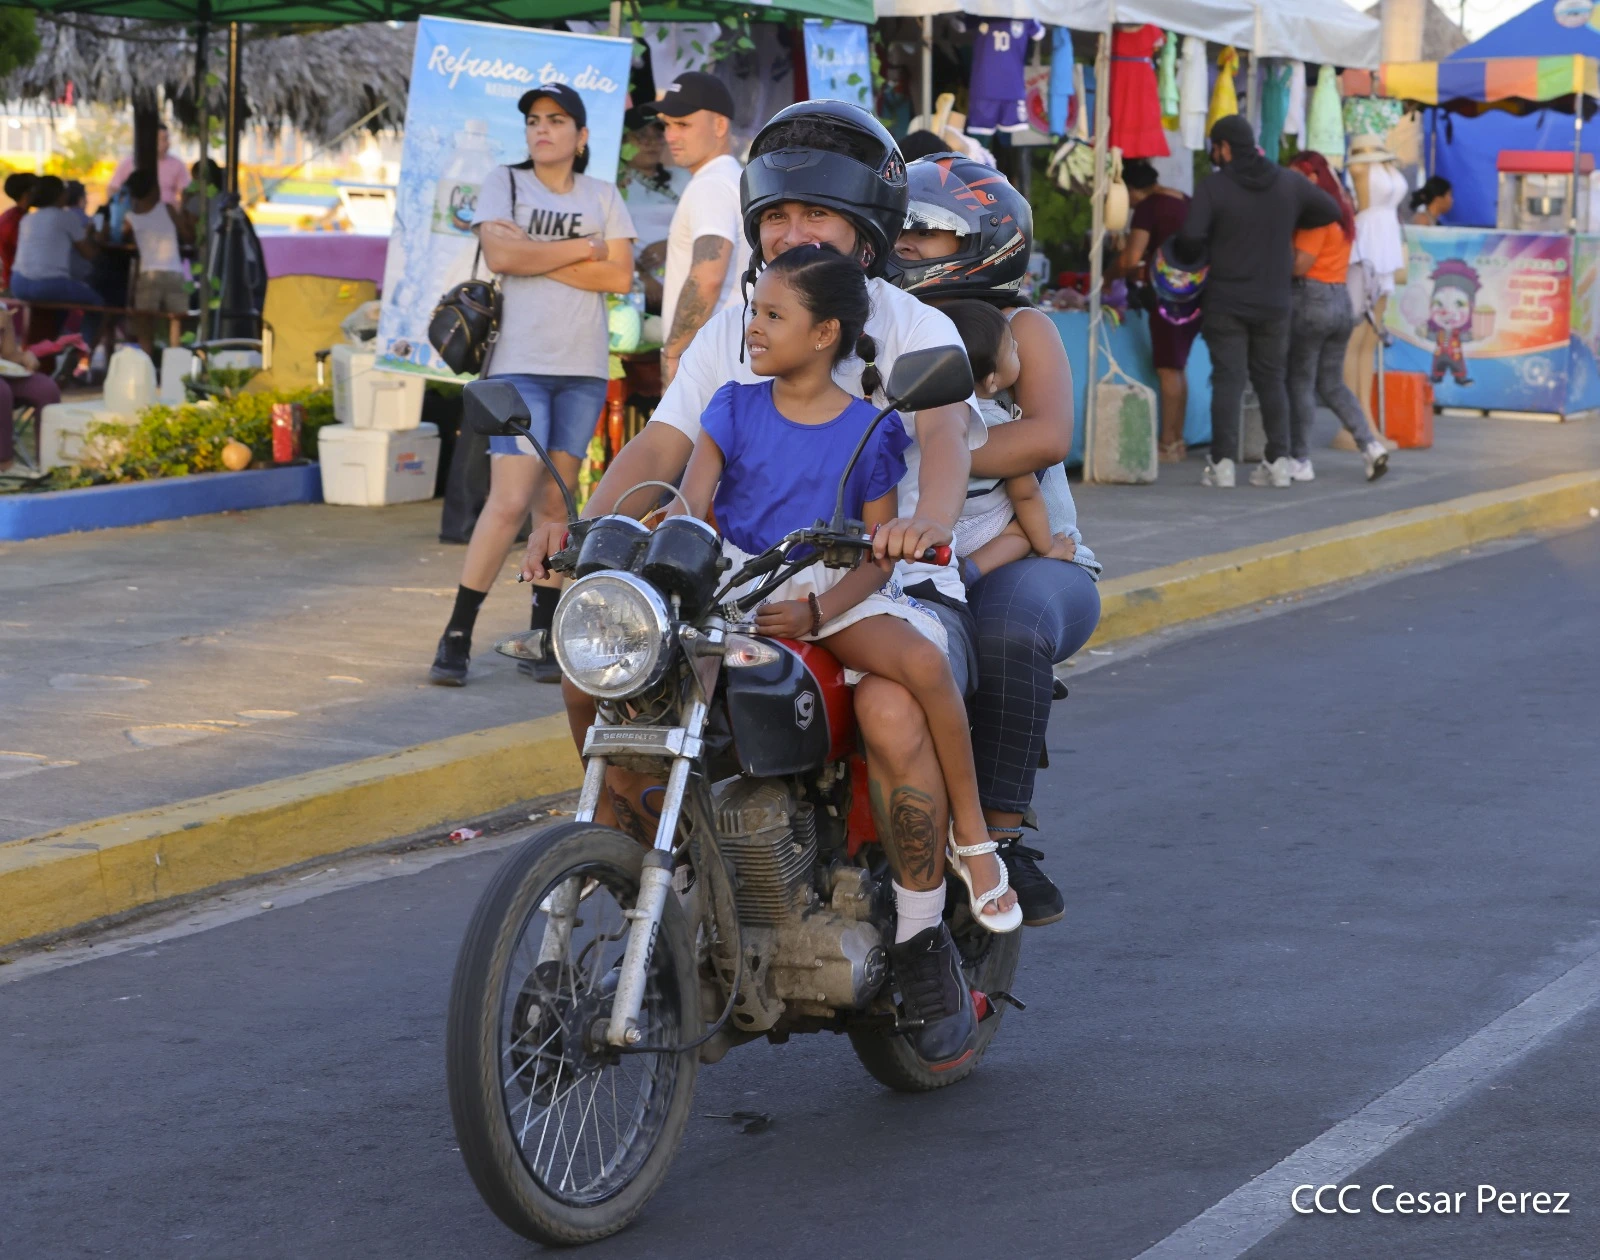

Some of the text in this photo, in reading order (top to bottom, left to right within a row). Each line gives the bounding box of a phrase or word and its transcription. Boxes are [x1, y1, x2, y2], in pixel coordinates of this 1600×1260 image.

[993, 30, 1010, 52] 10
[427, 44, 535, 90] Refresca
[538, 62, 570, 85] tu
[527, 208, 583, 238] NIKE
